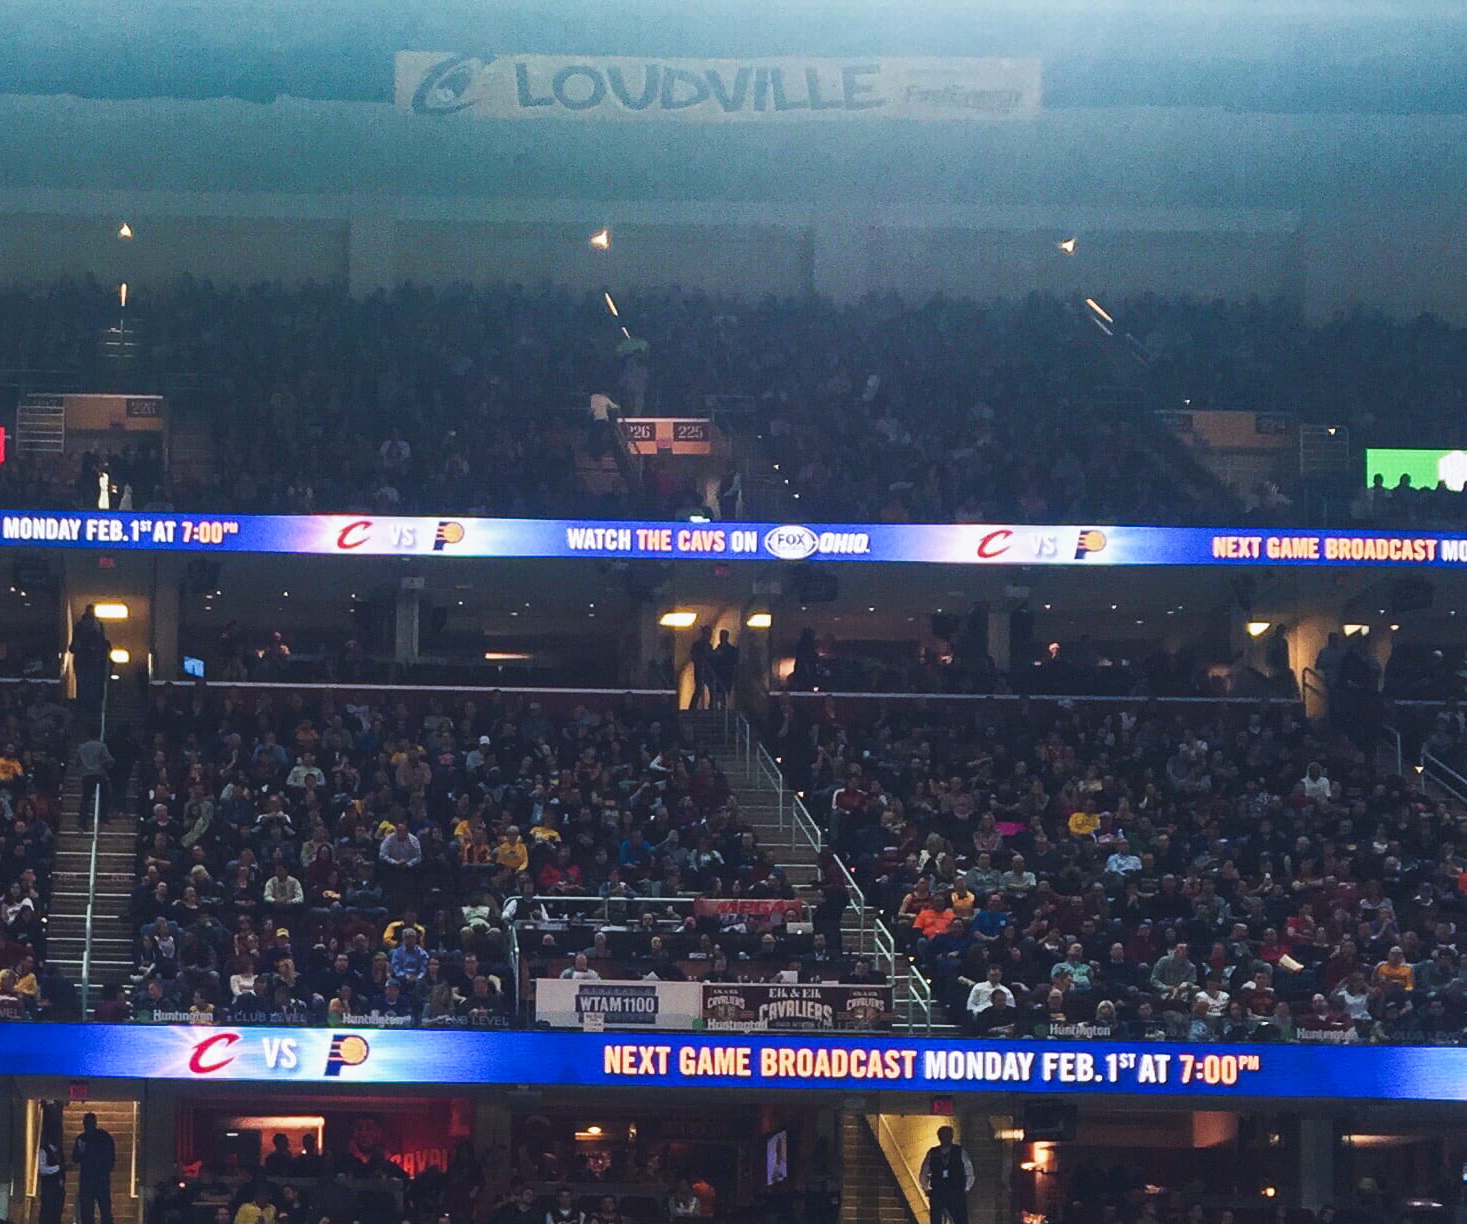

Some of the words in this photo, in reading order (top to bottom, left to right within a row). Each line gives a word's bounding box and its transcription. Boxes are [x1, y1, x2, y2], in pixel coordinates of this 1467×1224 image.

[514, 61, 882, 111] LOUDVILLE
[677, 425, 704, 439] 225
[3, 518, 81, 540] MONDAY
[86, 519, 129, 542] FEB.
[154, 522, 176, 542] AT
[181, 521, 239, 544] 7:00PM
[390, 523, 416, 548] VS
[567, 527, 631, 550] WATCH
[637, 529, 672, 552] THE
[678, 530, 726, 552] CAVS
[731, 531, 758, 553] ON
[777, 533, 806, 547] FOX
[1033, 533, 1056, 555] VS
[1213, 535, 1261, 558] NEXT
[1266, 537, 1320, 560] GAME
[1325, 538, 1437, 561] BROADCAST
[769, 988, 787, 998] Elk
[790, 989, 801, 998] &
[802, 989, 822, 999] Elk
[153, 1009, 214, 1024] Huntington
[758, 999, 833, 1027] CAVALIERS
[1049, 1023, 1112, 1039] Huntington
[262, 1037, 298, 1070] VS
[603, 1045, 669, 1077] NEXT
[678, 1047, 752, 1079] GAME
[760, 1048, 918, 1080] BROADCAST
[924, 1051, 1035, 1082] MONDAY
[1041, 1052, 1103, 1084] FEB.
[1105, 1053, 1136, 1084] 1ST
[1137, 1054, 1170, 1085] AT
[1179, 1054, 1261, 1086] 7:00PM
